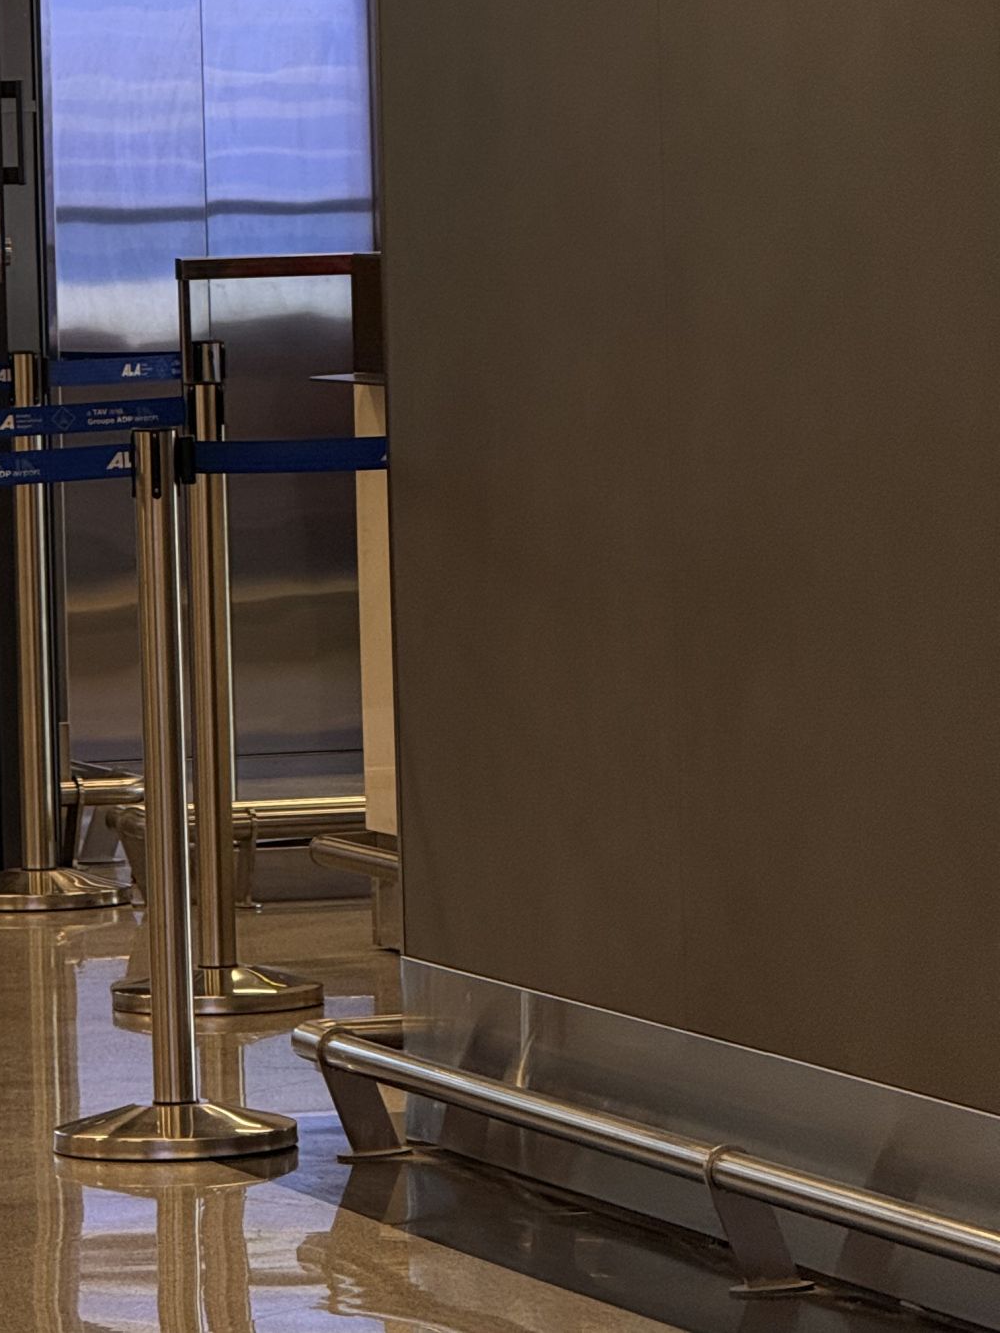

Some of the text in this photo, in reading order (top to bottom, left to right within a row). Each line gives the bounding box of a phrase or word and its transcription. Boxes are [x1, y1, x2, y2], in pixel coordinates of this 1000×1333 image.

[121, 362, 141, 377] ALA
[106, 451, 132, 470] AL
[12, 469, 41, 477] airport
